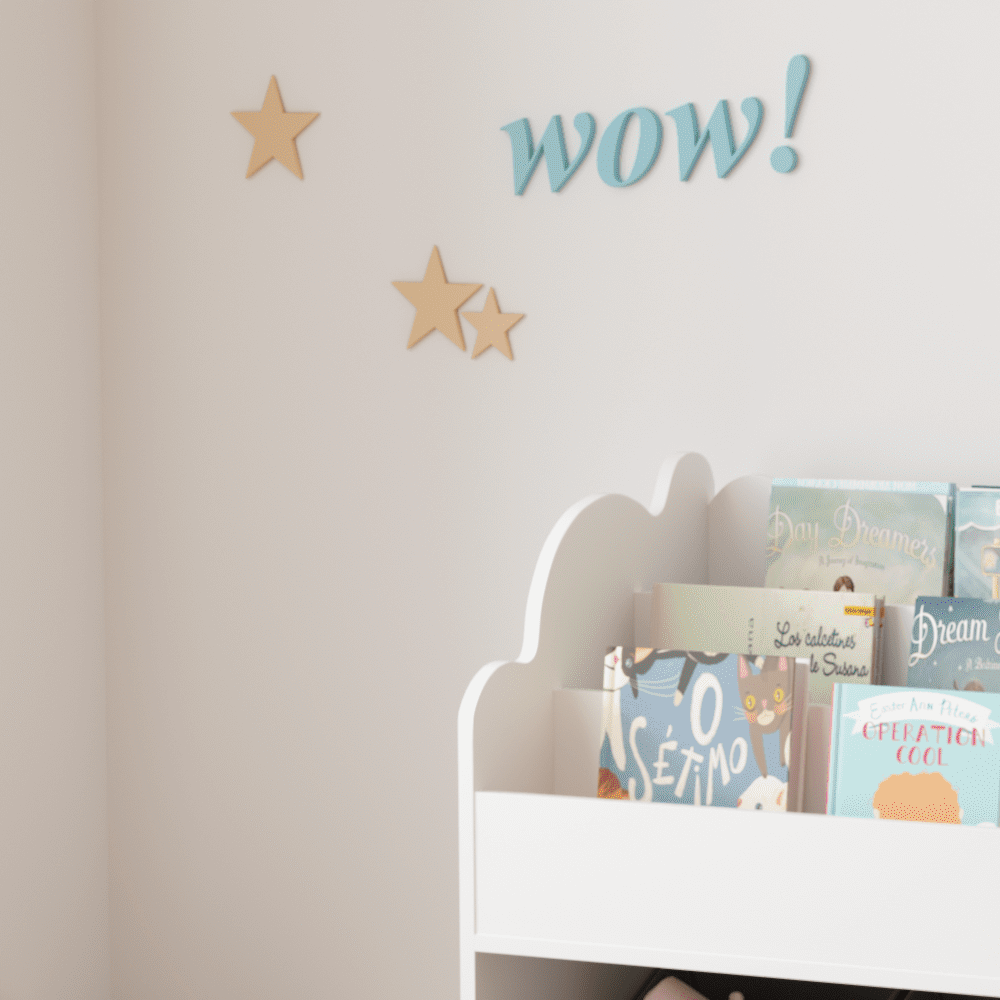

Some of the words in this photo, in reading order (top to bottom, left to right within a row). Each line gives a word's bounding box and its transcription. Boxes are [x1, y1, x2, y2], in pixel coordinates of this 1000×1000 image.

[765, 505, 819, 557] Day
[828, 498, 937, 566] Dreamers
[774, 620, 801, 649] Los
[908, 604, 991, 667] Dream
[822, 652, 870, 677] Susana
[690, 672, 723, 746] O
[862, 721, 986, 747] OPERATION
[896, 745, 949, 766] COOL
